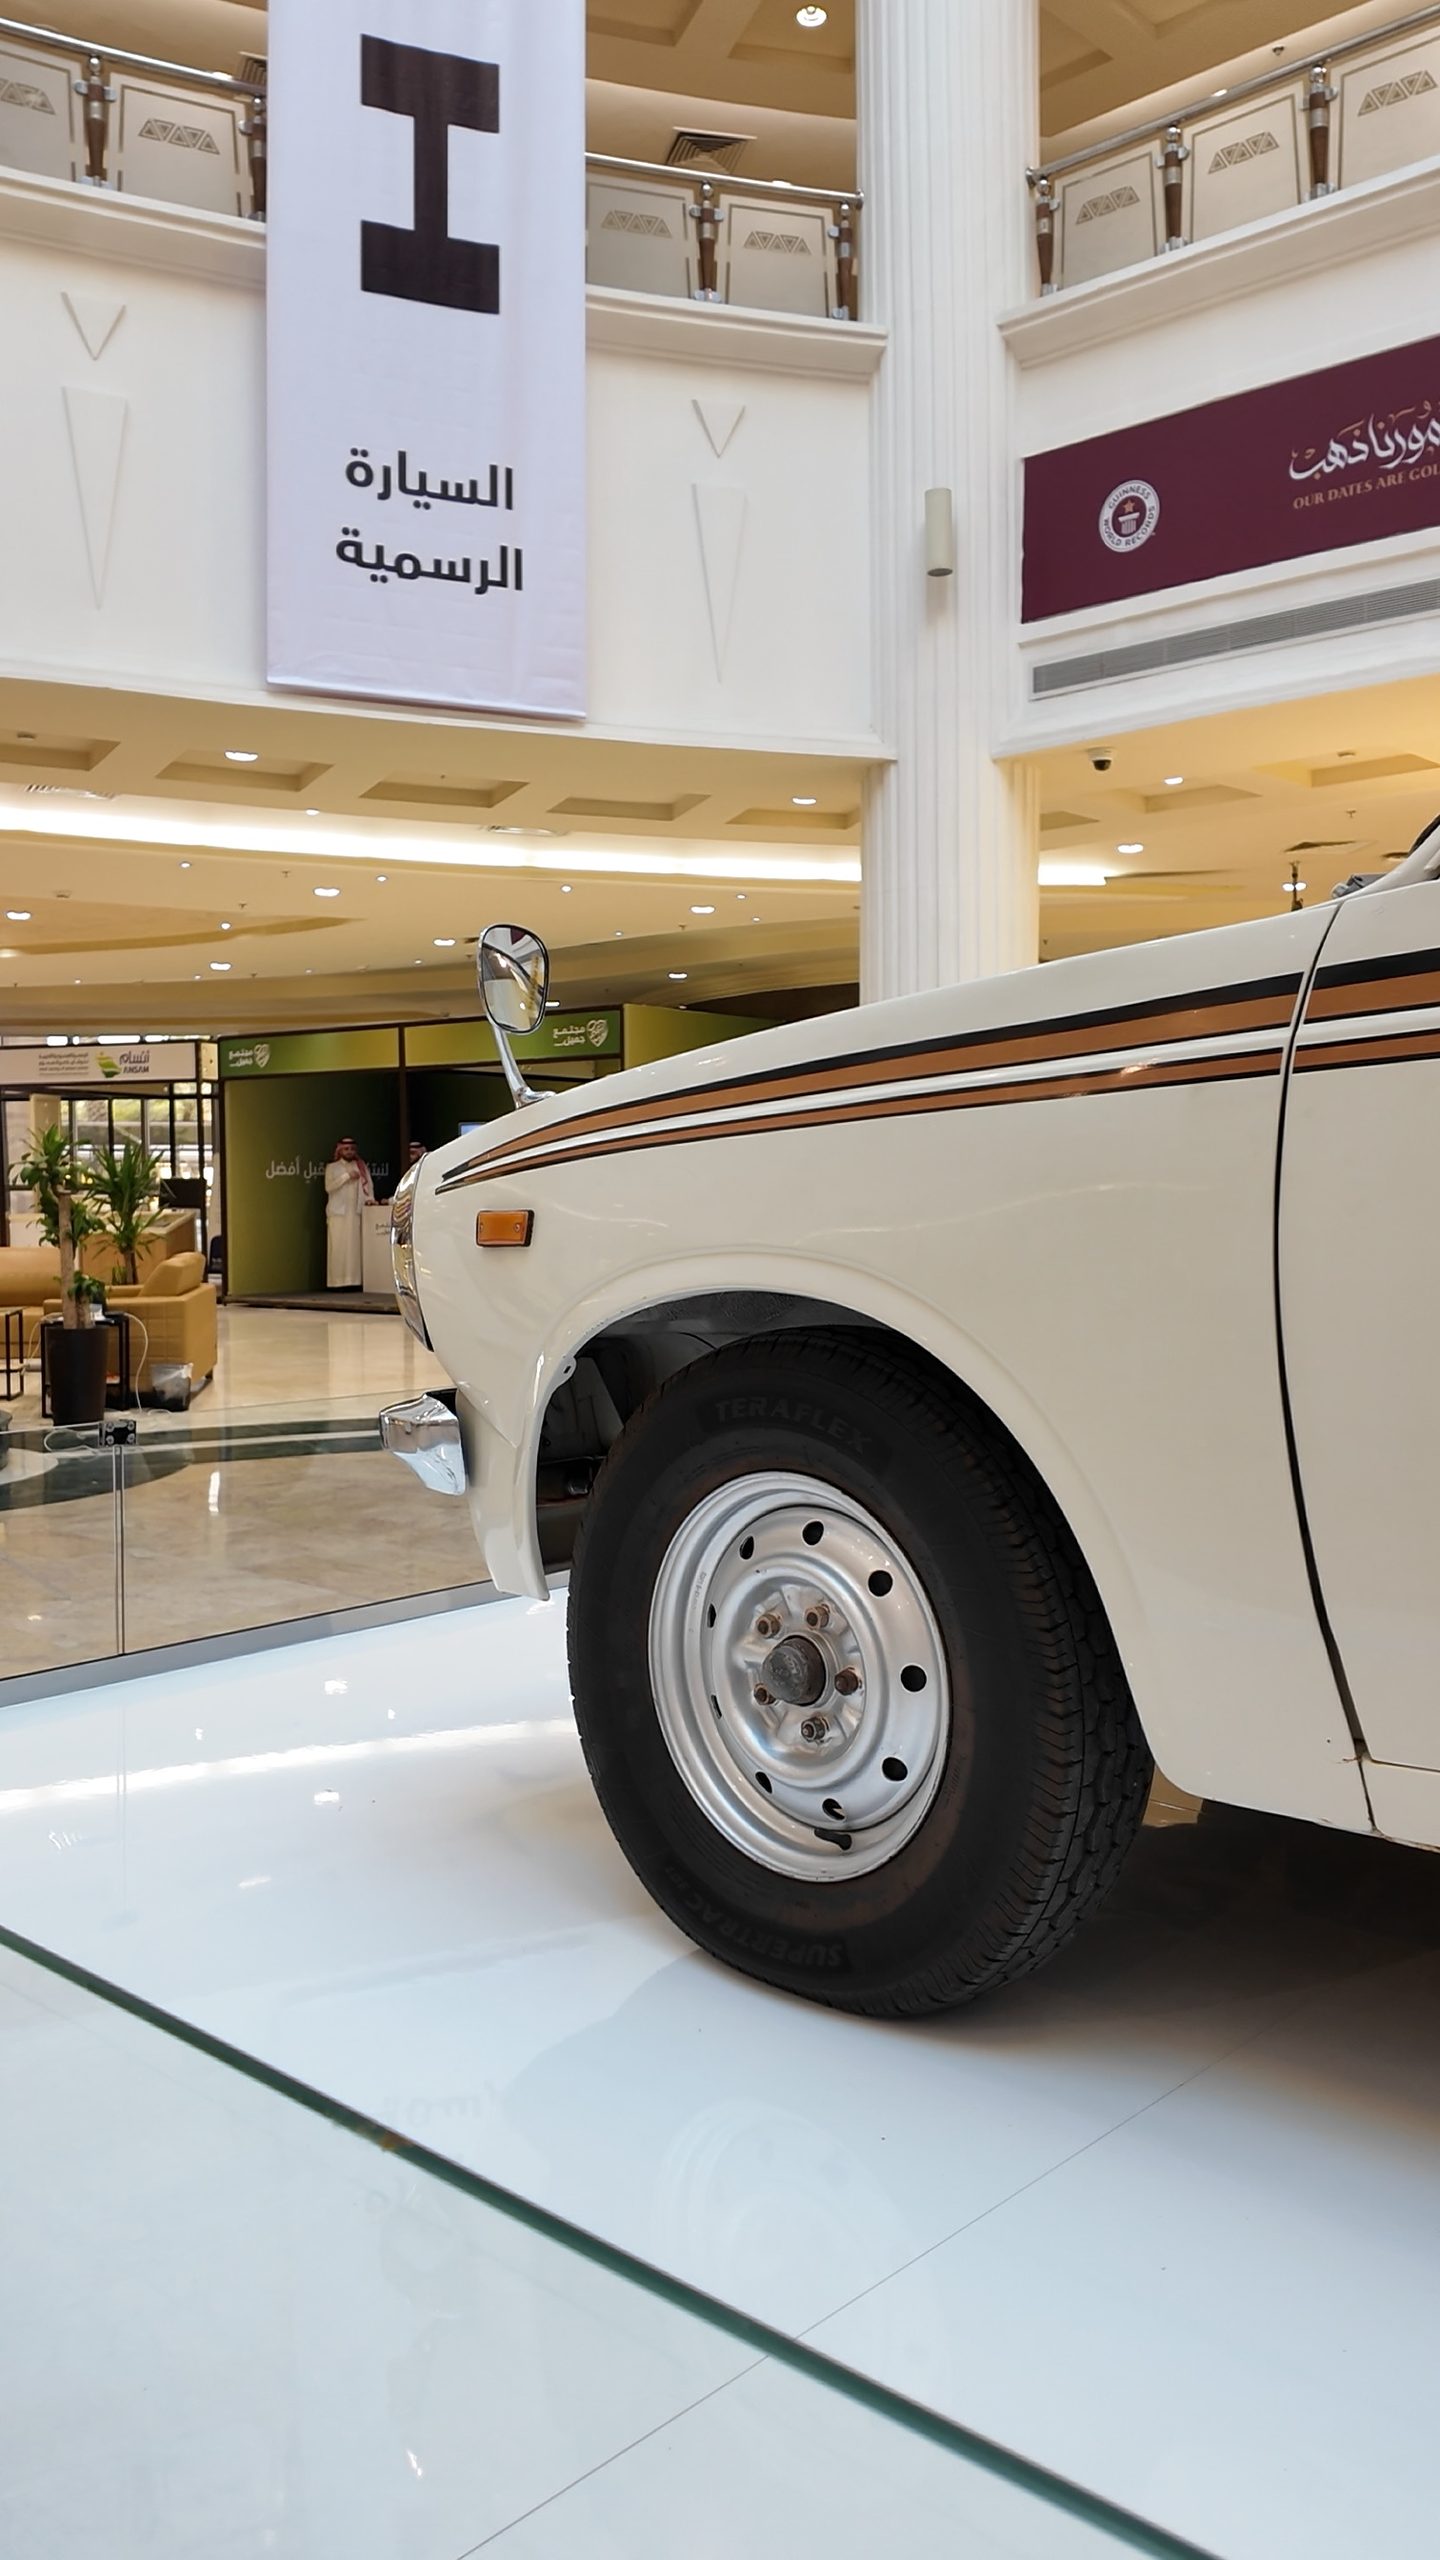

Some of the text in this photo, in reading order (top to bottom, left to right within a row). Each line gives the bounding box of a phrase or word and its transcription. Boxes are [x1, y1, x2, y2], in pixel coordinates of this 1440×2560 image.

[345, 447, 514, 511] السيارة
[1108, 485, 1151, 509] GUINNESS
[1293, 492, 1325, 510] OUR
[1328, 480, 1373, 502] DATES
[1376, 471, 1408, 490] ARE
[1103, 505, 1156, 547] WORLD RECORDS
[335, 526, 523, 595] الرسمية
[715, 1395, 872, 1455] TERAFLEX
